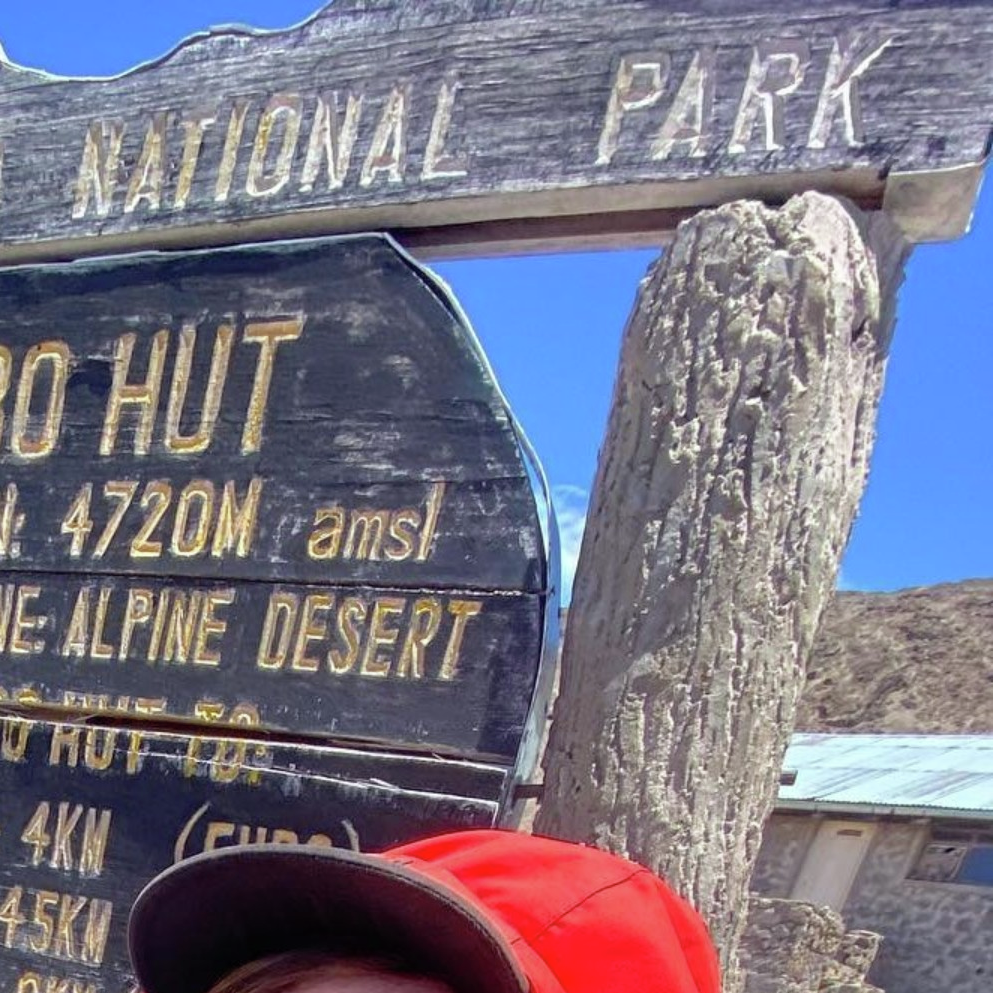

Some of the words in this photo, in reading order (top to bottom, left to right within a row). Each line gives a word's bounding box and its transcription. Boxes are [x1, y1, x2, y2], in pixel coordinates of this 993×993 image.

[72, 82, 468, 219] NATIONAL
[594, 36, 897, 166] PARK
[97, 313, 304, 456] HUT
[59, 476, 263, 560] 4720M
[305, 483, 445, 564] amsl
[61, 584, 237, 668] ALPINE
[256, 593, 483, 683] DESERT
[48, 689, 167, 775] HUT
[19, 801, 113, 878] 4KM
